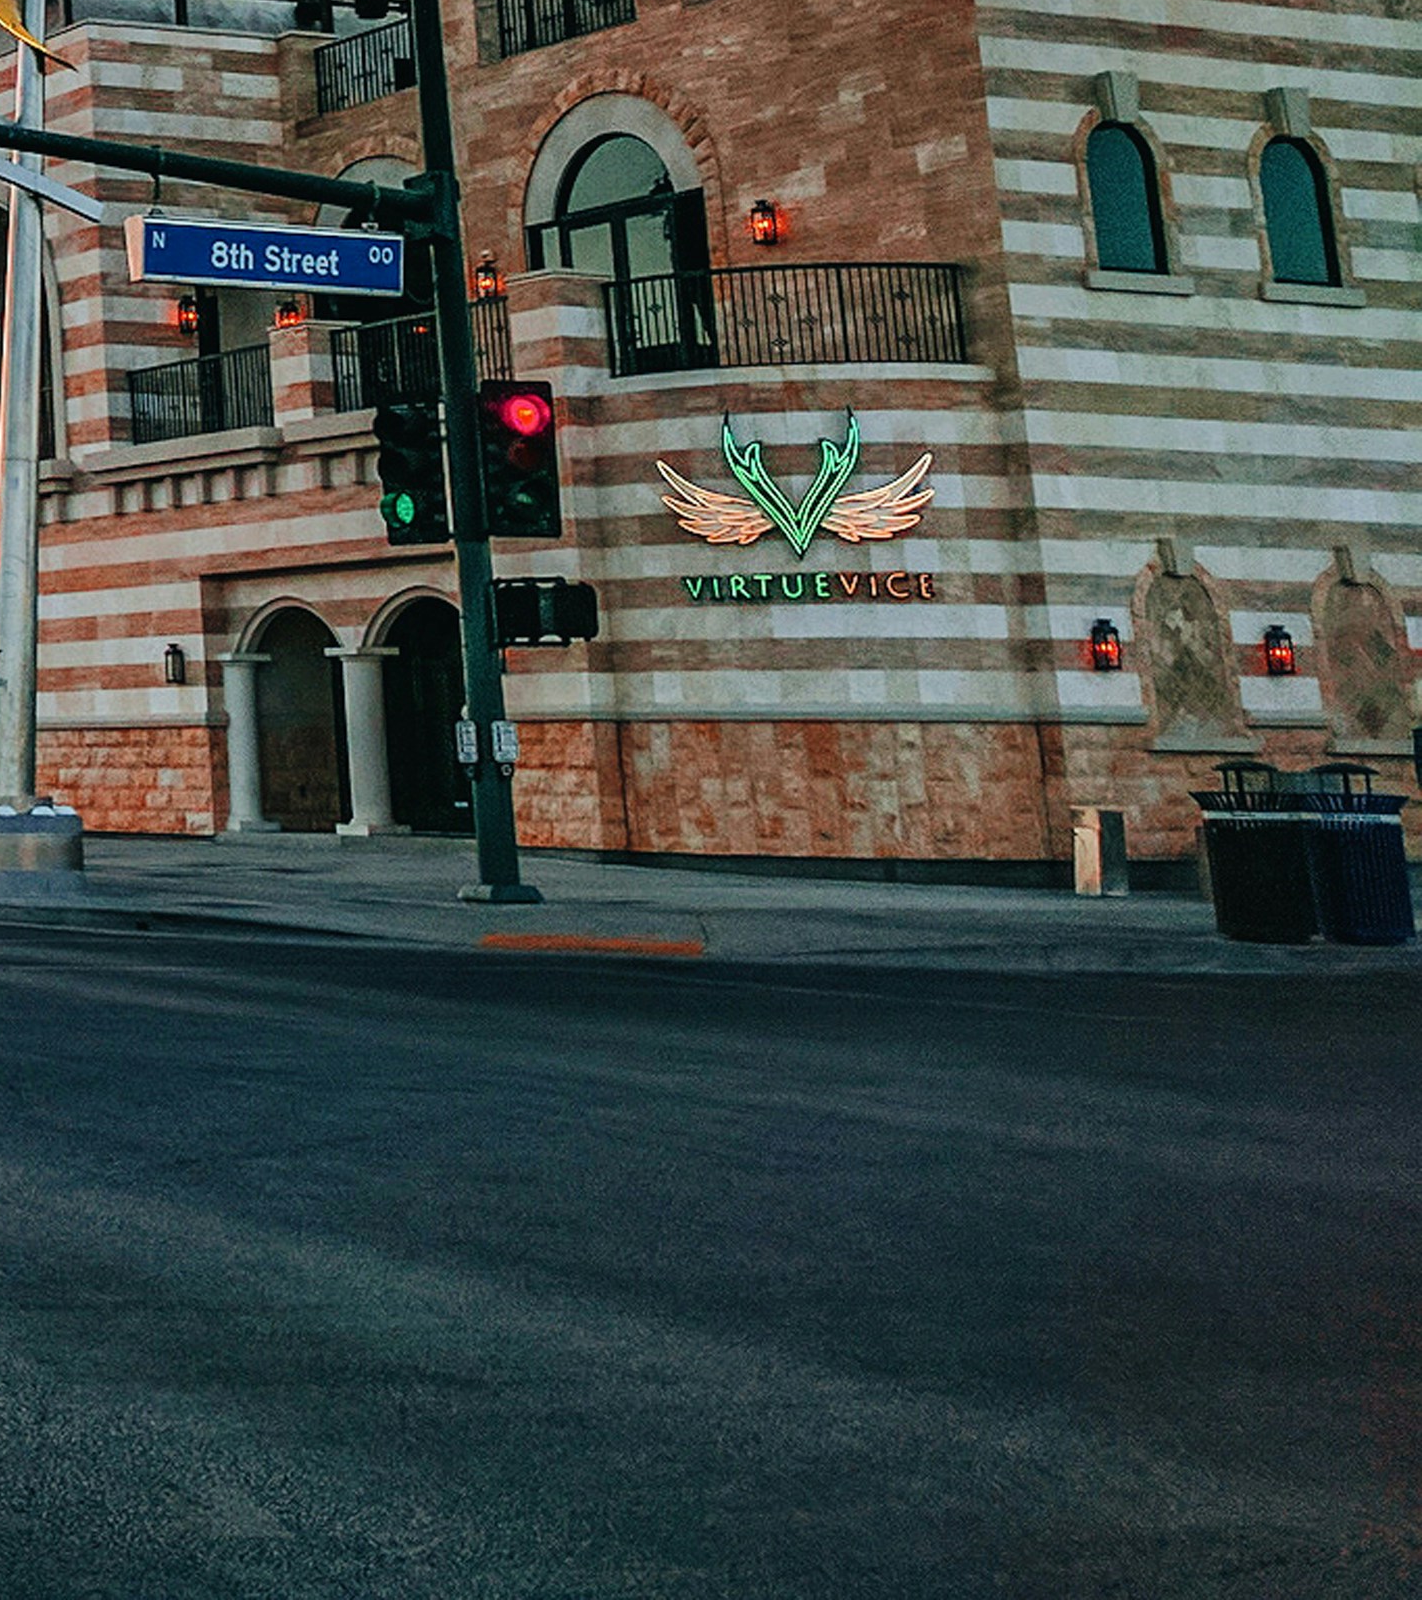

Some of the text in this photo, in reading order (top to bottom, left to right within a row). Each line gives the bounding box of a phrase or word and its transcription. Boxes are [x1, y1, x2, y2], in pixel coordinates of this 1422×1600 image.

[152, 231, 394, 277] N 8th Street 00
